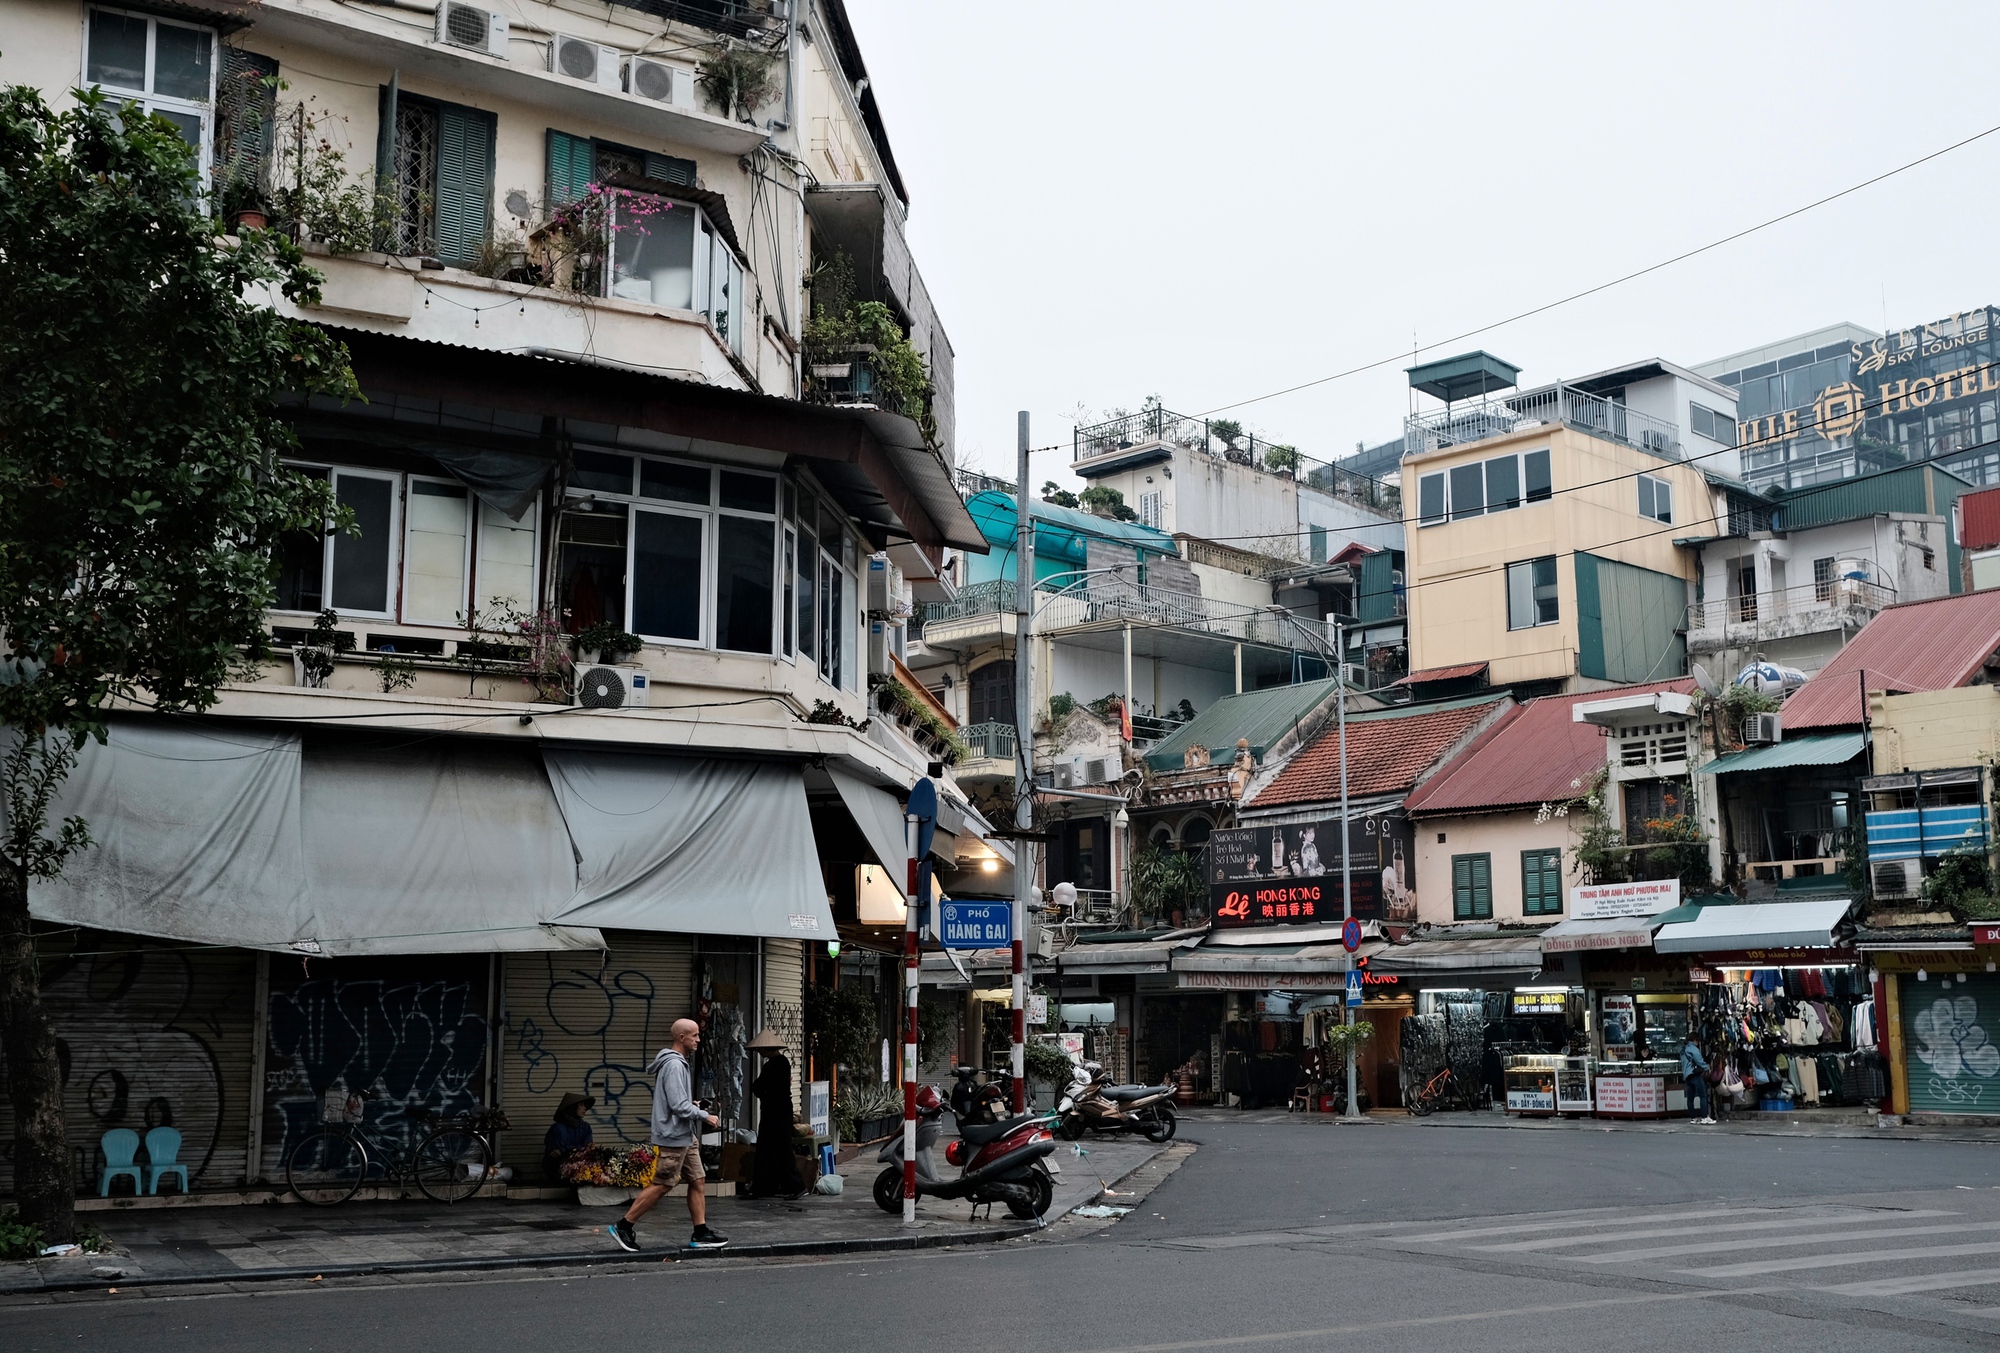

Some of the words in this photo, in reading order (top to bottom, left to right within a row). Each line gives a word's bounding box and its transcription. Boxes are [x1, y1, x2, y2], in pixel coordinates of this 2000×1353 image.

[1851, 307, 1987, 363] SCENYC
[1888, 350, 1916, 366] SKY
[1922, 330, 1988, 357] LOUNGE
[1879, 362, 2000, 416] HOTEL
[1738, 664, 1772, 679] SONHA
[1235, 830, 1253, 843] Uống
[1256, 888, 1288, 903] HONG
[1289, 886, 1321, 901] KONG
[1580, 890, 1598, 899] TRUNG
[1598, 888, 1610, 898] TÂM
[1611, 888, 1623, 897] ANH
[1660, 884, 1672, 893] MAI
[968, 906, 990, 918] PHỐ
[1217, 891, 1251, 920] Lệ
[1261, 901, 1315, 918] 映丽香港
[947, 919, 981, 939] HÀNG
[985, 924, 1006, 939] GAI
[1618, 935, 1646, 947] NGỌC
[1746, 950, 1766, 959] 105
[1768, 951, 1789, 959] HÀNG
[1509, 1099, 1518, 1108] PIN
